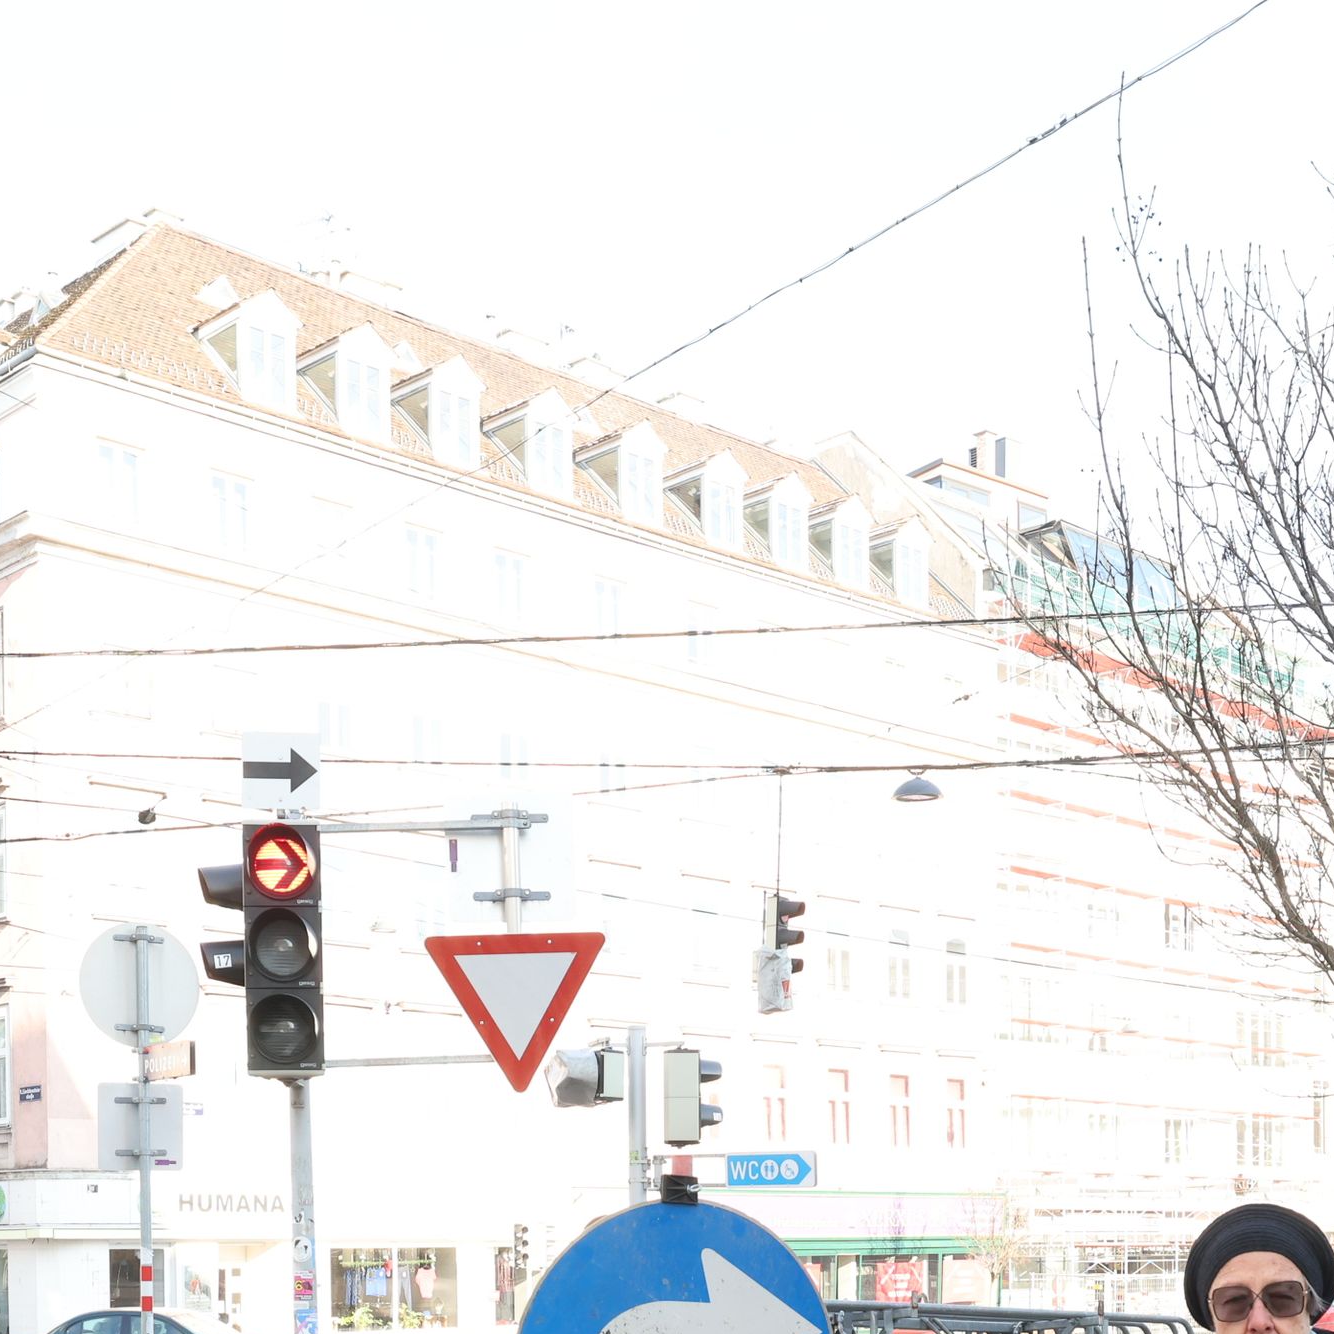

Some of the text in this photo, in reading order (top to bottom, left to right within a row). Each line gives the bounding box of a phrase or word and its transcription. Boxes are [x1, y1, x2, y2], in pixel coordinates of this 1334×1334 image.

[216, 955, 232, 967] 17
[144, 1055, 176, 1073] POLIZEI
[730, 1160, 759, 1181] WC
[178, 1193, 285, 1213] HUMANA
